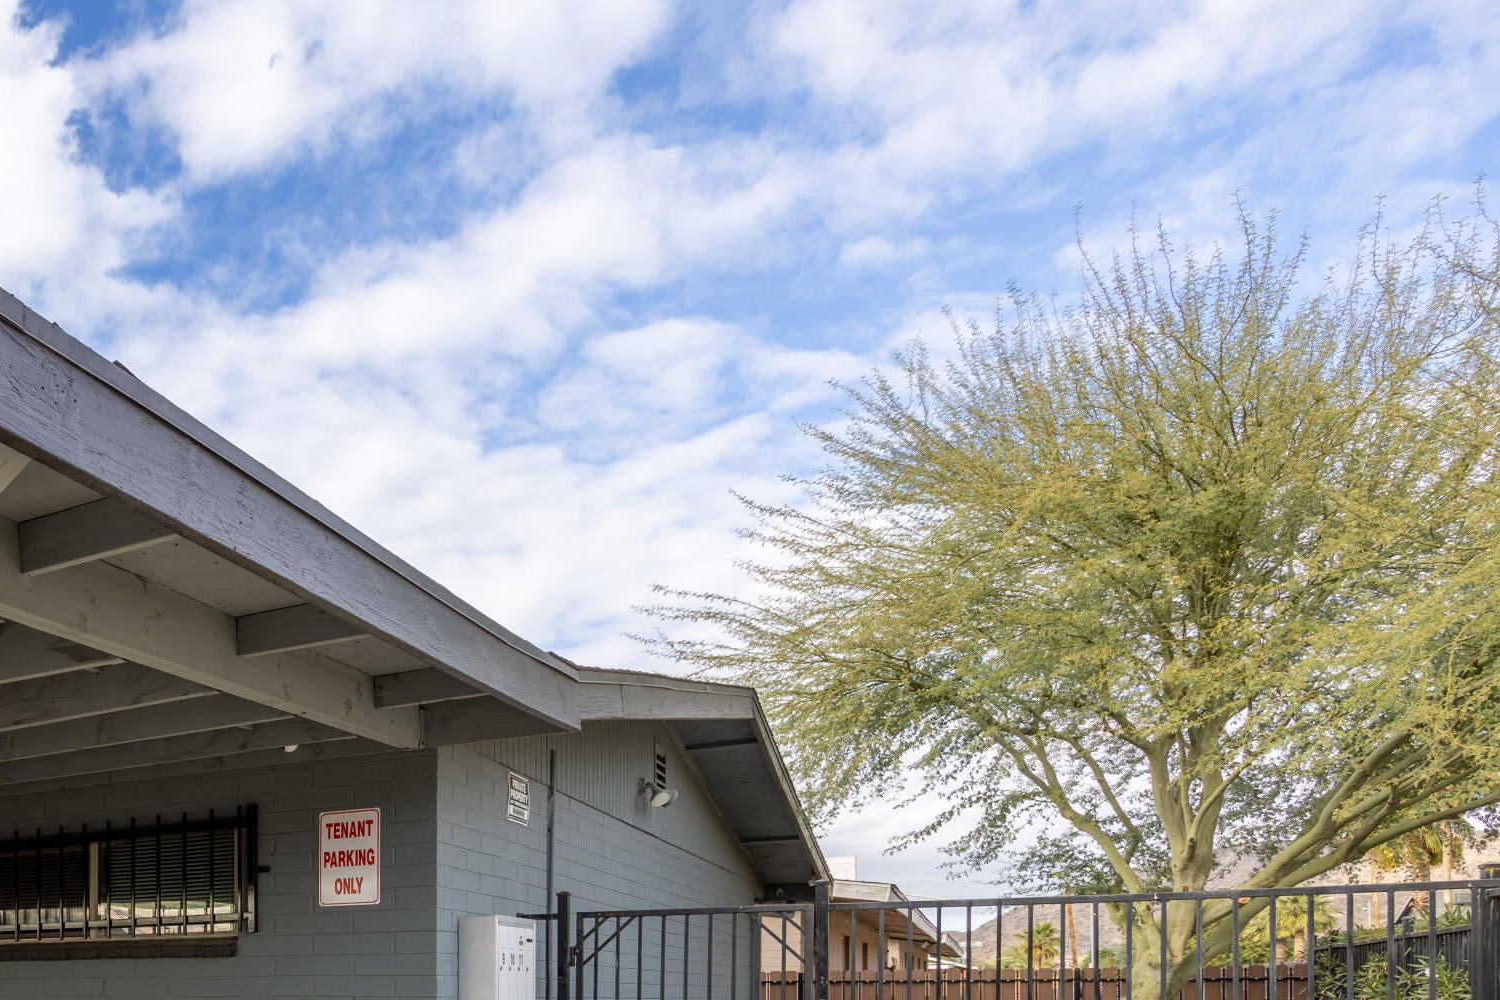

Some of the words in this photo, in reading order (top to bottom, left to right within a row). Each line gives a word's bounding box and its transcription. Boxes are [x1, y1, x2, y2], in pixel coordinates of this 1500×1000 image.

[326, 820, 373, 839] TENANT
[323, 848, 375, 868] PARKING
[334, 877, 363, 895] ONLY
